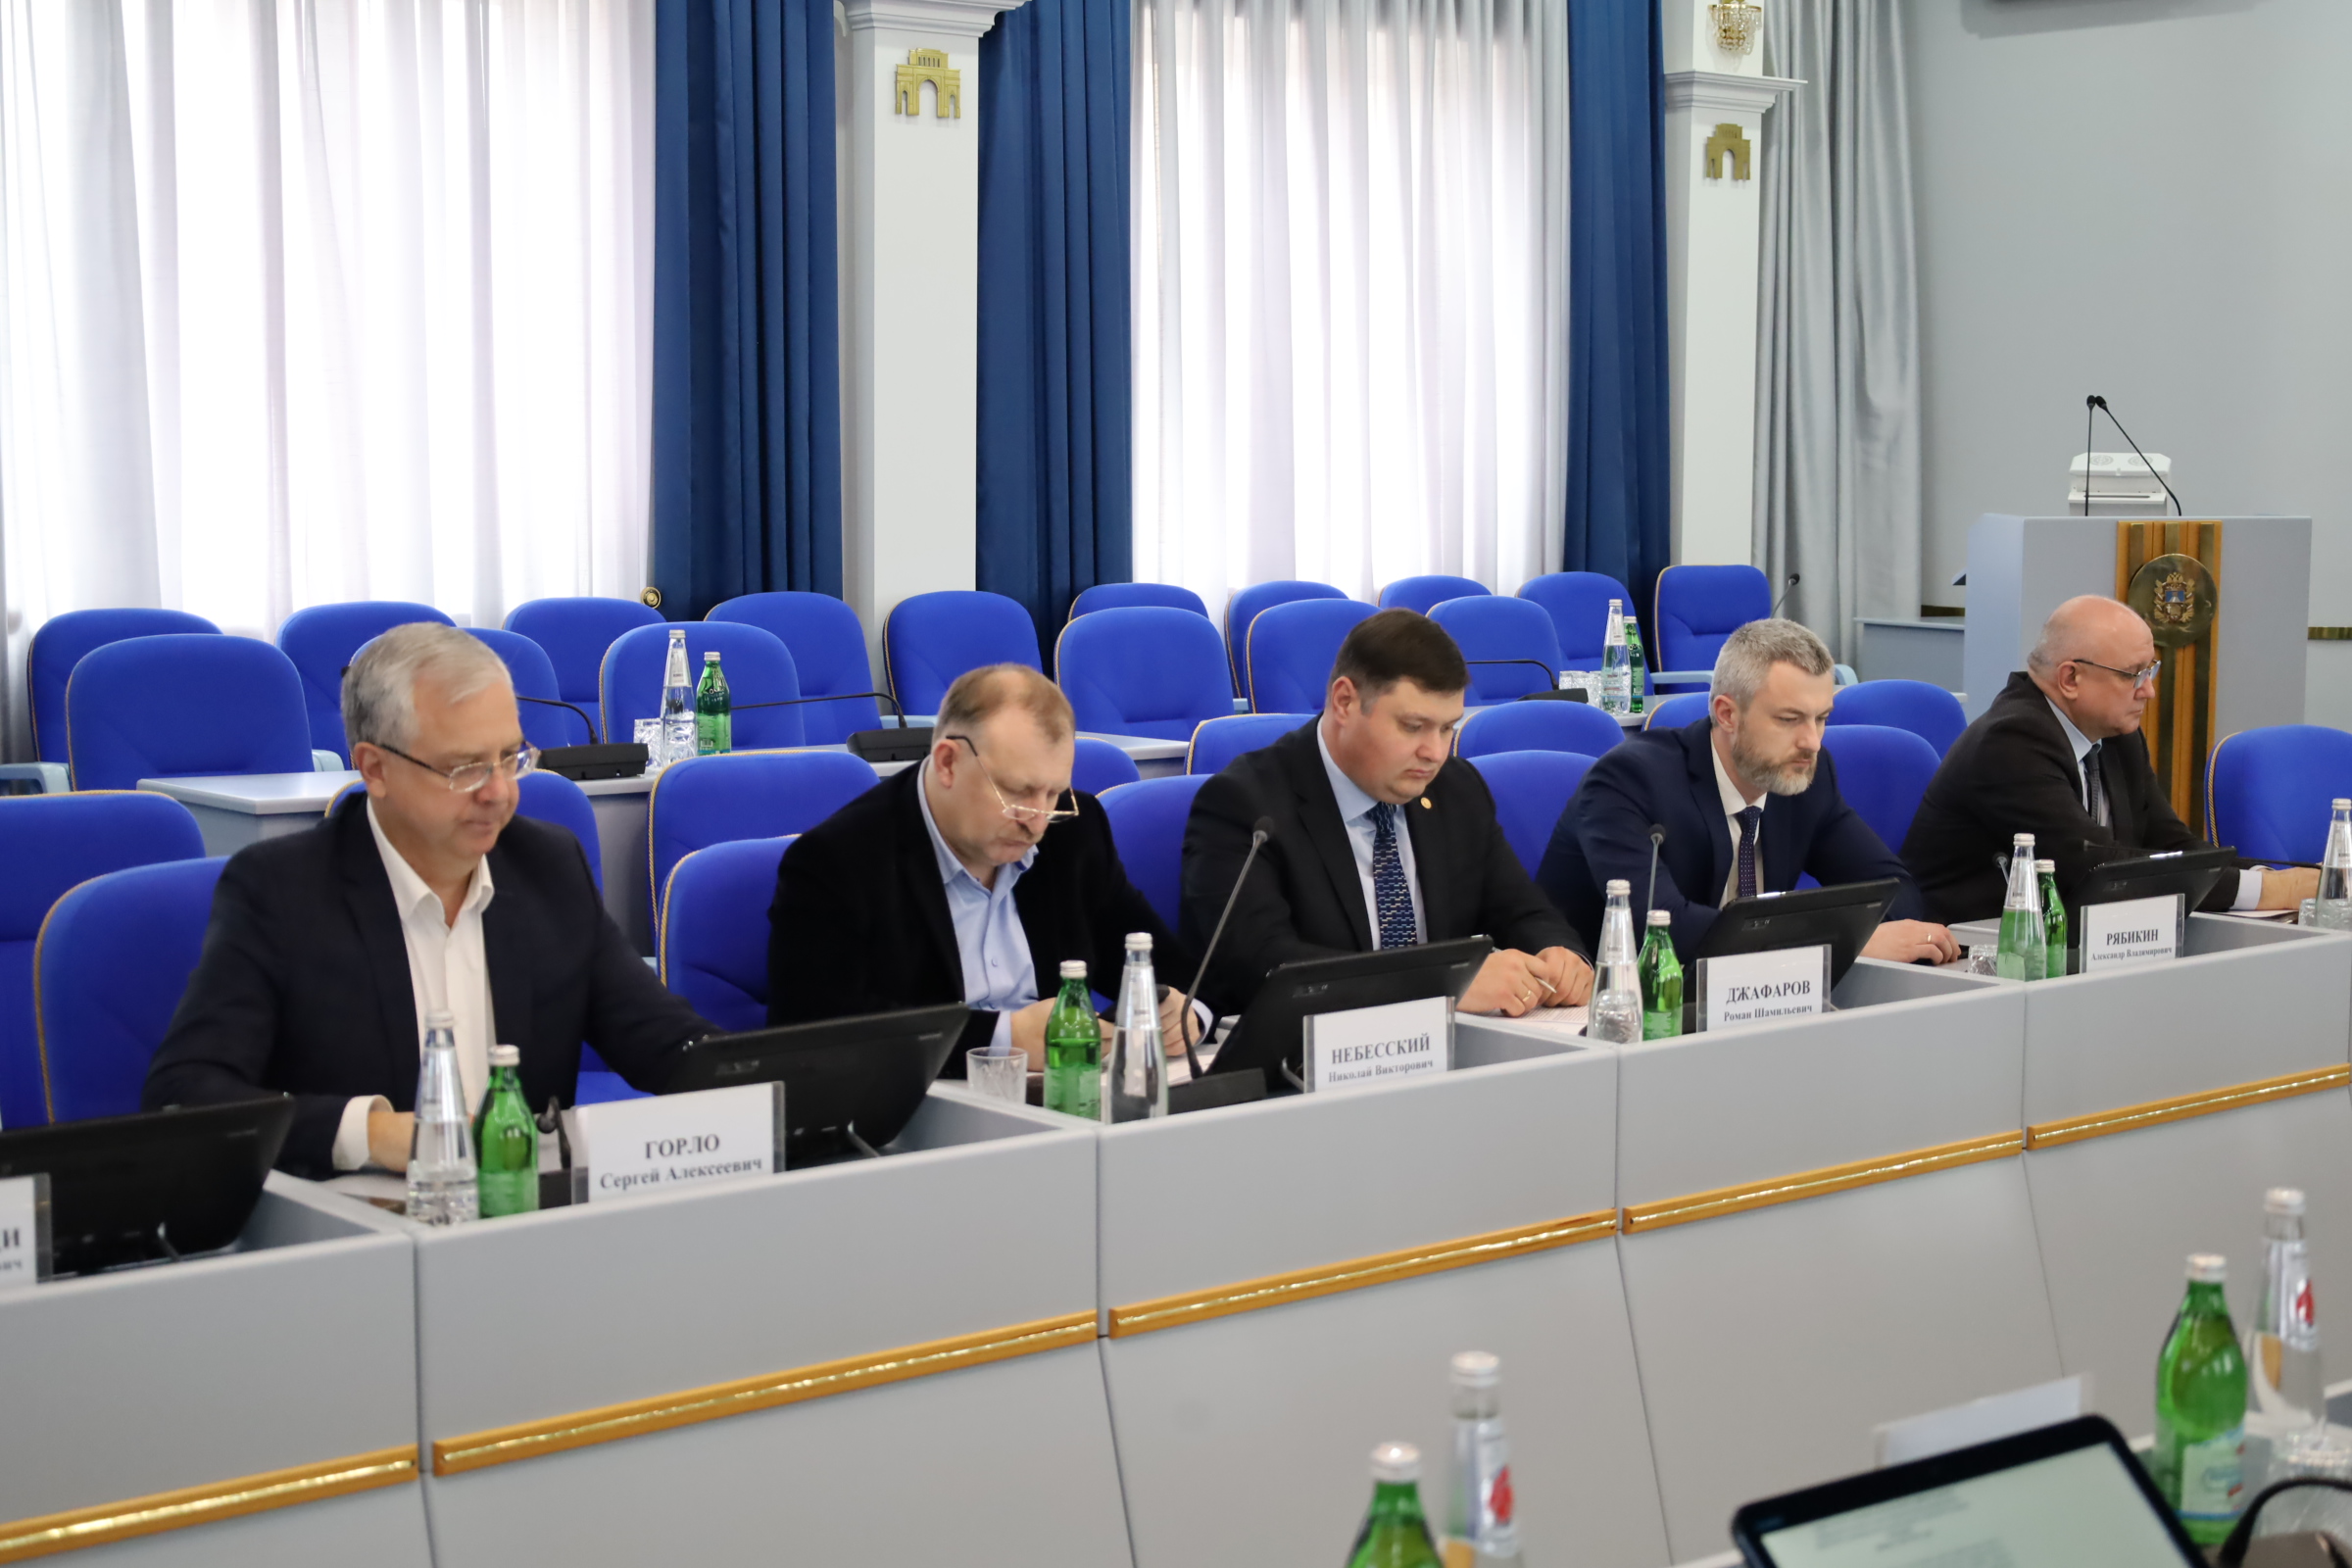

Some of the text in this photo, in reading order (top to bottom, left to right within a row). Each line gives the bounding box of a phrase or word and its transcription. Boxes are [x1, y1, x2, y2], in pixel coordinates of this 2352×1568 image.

[2106, 929, 2159, 946] РЯБИКИН
[1726, 980, 1811, 1004] ДЖАФАРОВ
[1724, 1004, 1812, 1022] Роман Шамильевич
[1332, 1033, 1431, 1064] НЕБЕССКИЙ
[1329, 1058, 1434, 1082] Николай Викторович
[644, 1133, 720, 1159] ГОРЛО
[600, 1157, 762, 1191] Сергей Алексеевич
